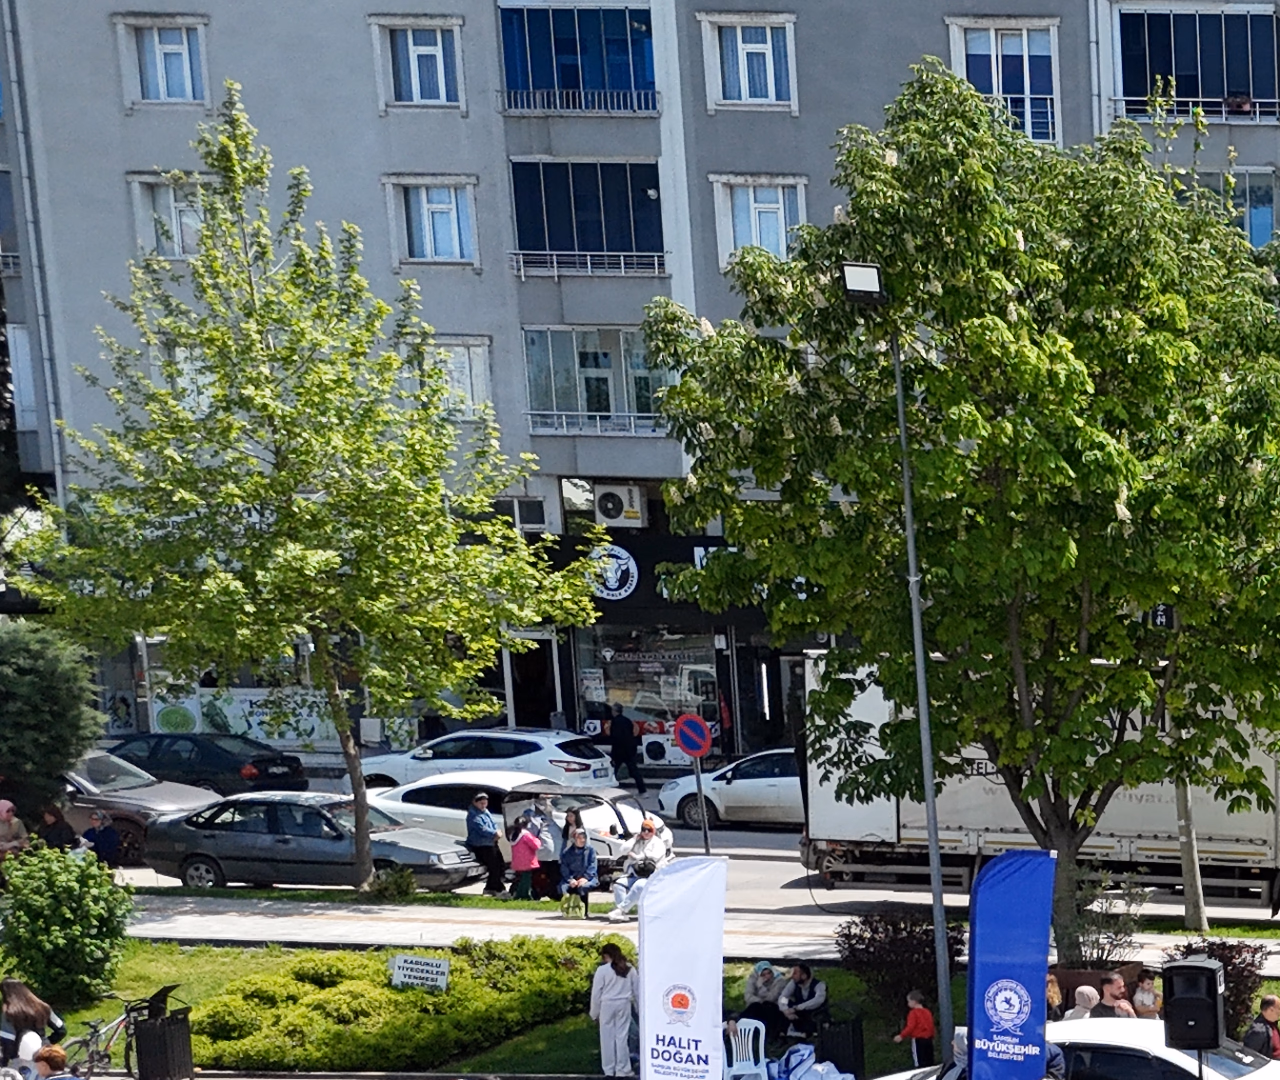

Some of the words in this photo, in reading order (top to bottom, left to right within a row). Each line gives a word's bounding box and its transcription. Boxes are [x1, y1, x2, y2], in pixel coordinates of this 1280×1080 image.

[656, 1033, 702, 1051] HALİT
[975, 1039, 1041, 1056] BÜYÜKŞEHİR
[651, 1047, 709, 1066] DOĞAN
